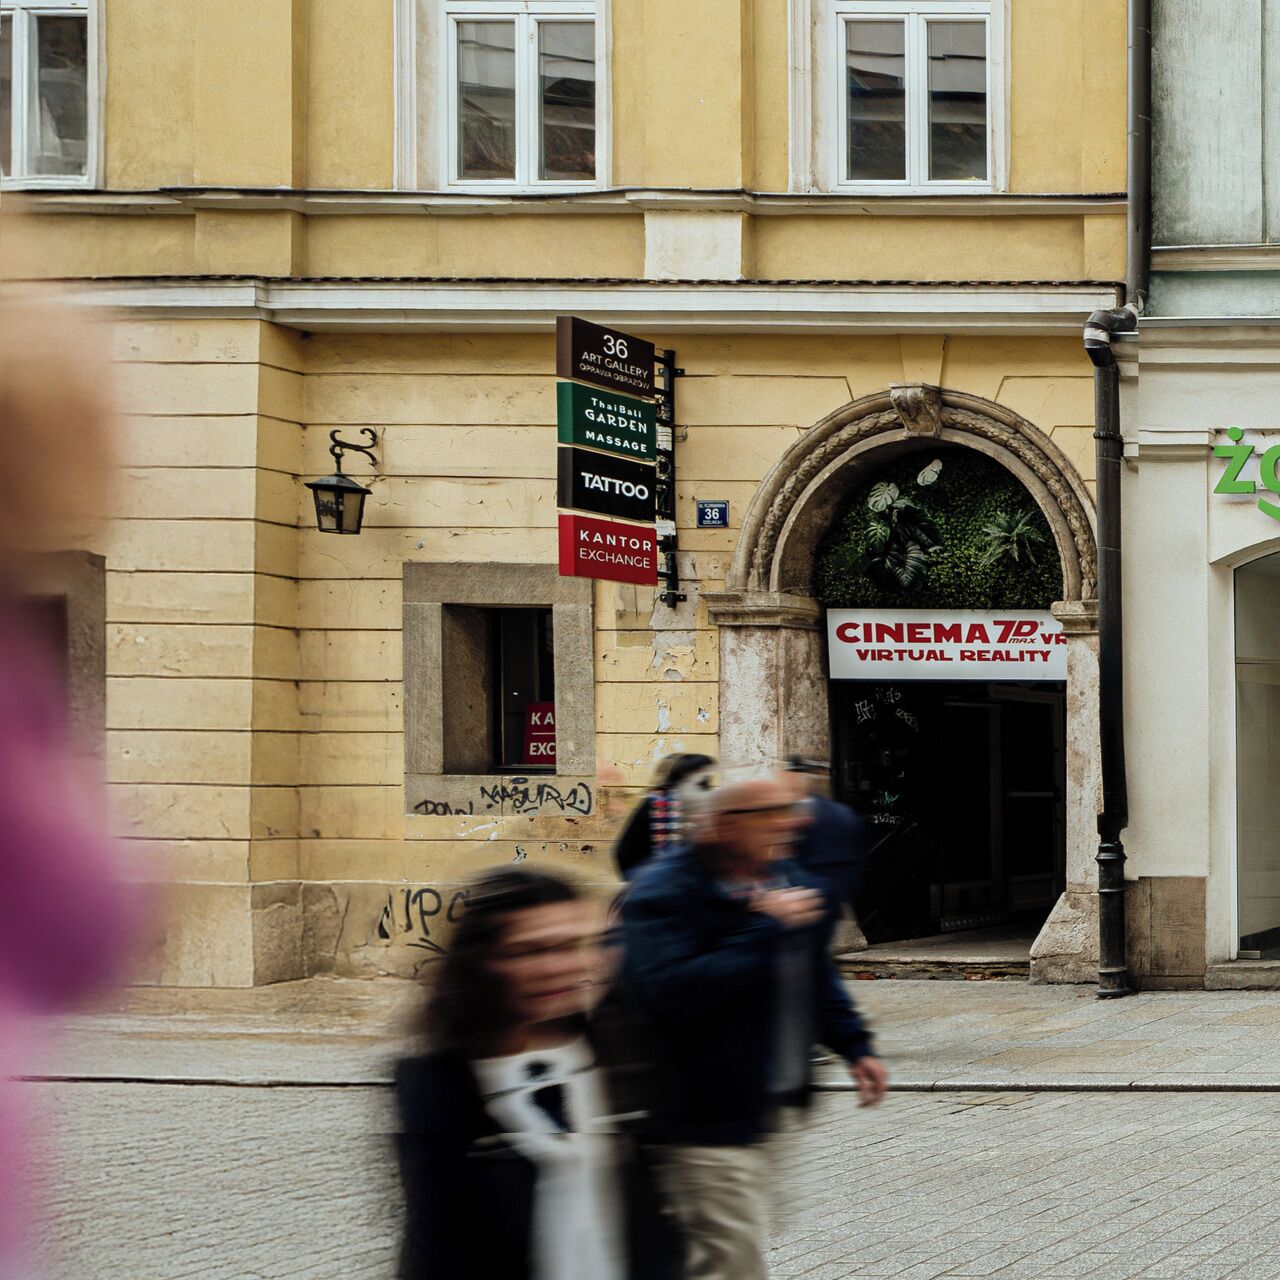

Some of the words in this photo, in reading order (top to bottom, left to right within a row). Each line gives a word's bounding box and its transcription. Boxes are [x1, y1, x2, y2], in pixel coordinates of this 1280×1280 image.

[603, 334, 629, 359] 36
[579, 363, 612, 377] OPRAWA
[581, 351, 603, 364] ART
[604, 358, 649, 379] GALLERY
[591, 397, 642, 419] ThaiBali
[585, 409, 648, 434] GARDEN
[585, 431, 648, 452] MASSAGE
[581, 472, 649, 500] TATTOO
[705, 508, 720, 520] 36
[580, 529, 652, 552] KANTOR
[579, 547, 651, 569] EXCHANGE
[836, 622, 991, 643] CINEMA
[993, 620, 1040, 643] 7D
[855, 649, 953, 661] VIRTUAL
[960, 650, 1051, 662] REALITY
